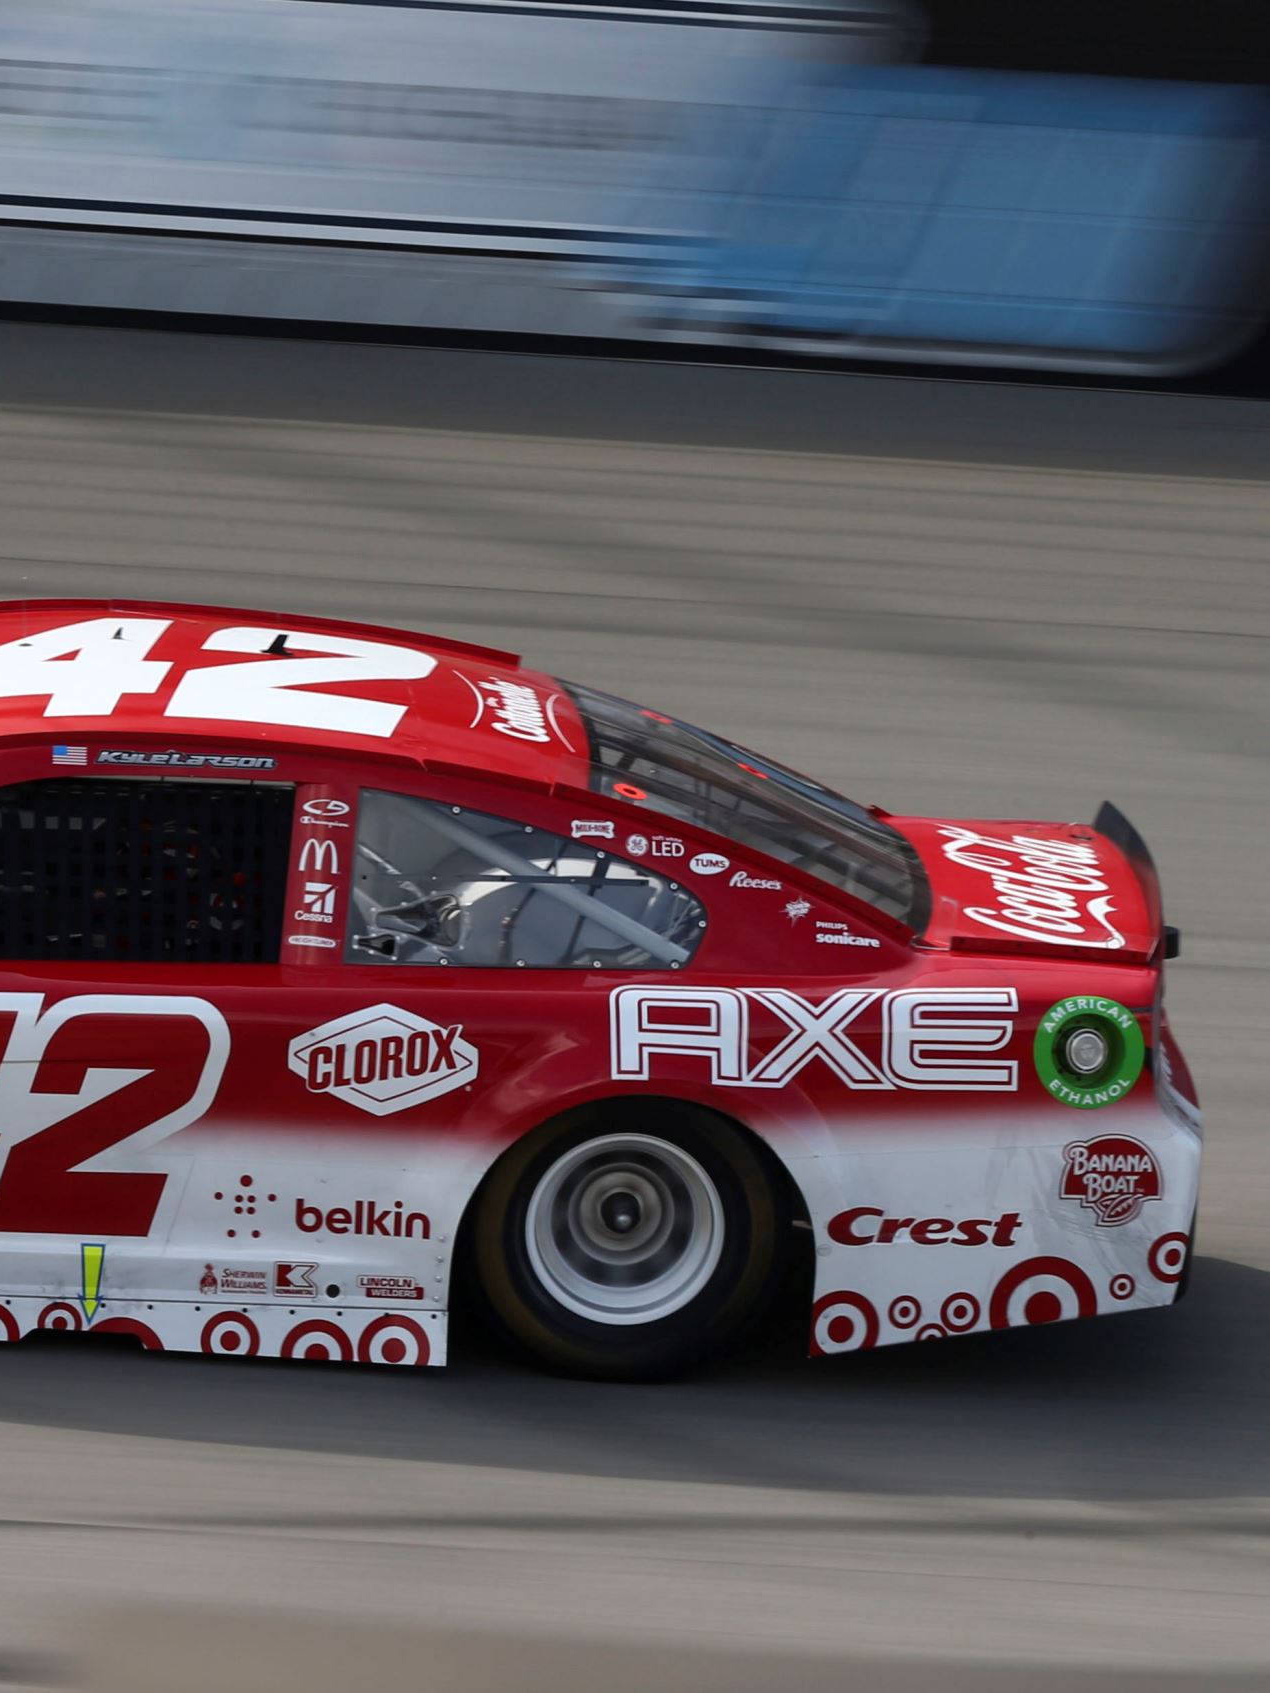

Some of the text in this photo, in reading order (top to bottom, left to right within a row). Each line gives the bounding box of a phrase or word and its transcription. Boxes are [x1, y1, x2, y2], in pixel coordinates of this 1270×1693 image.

[652, 841, 685, 857] LED
[695, 858, 726, 868] TUMS
[816, 921, 848, 930] PHILIPS
[816, 931, 881, 948] sonicare
[1043, 998, 1133, 1034] AMERICAN
[610, 985, 1019, 1092] AXE
[307, 1026, 461, 1091] CLOROX
[1049, 1079, 1131, 1105] ETHANOL
[1069, 1146, 1153, 1175] BANANA
[1082, 1173, 1139, 1199] BOAT
[296, 1198, 431, 1240] belkin
[827, 1206, 1023, 1248] Crest
[220, 1278, 267, 1291] WILLIAMS
[222, 1268, 267, 1280] SHERWIN
[360, 1277, 413, 1288] LINCOLN
[370, 1287, 418, 1299] WELDERS
